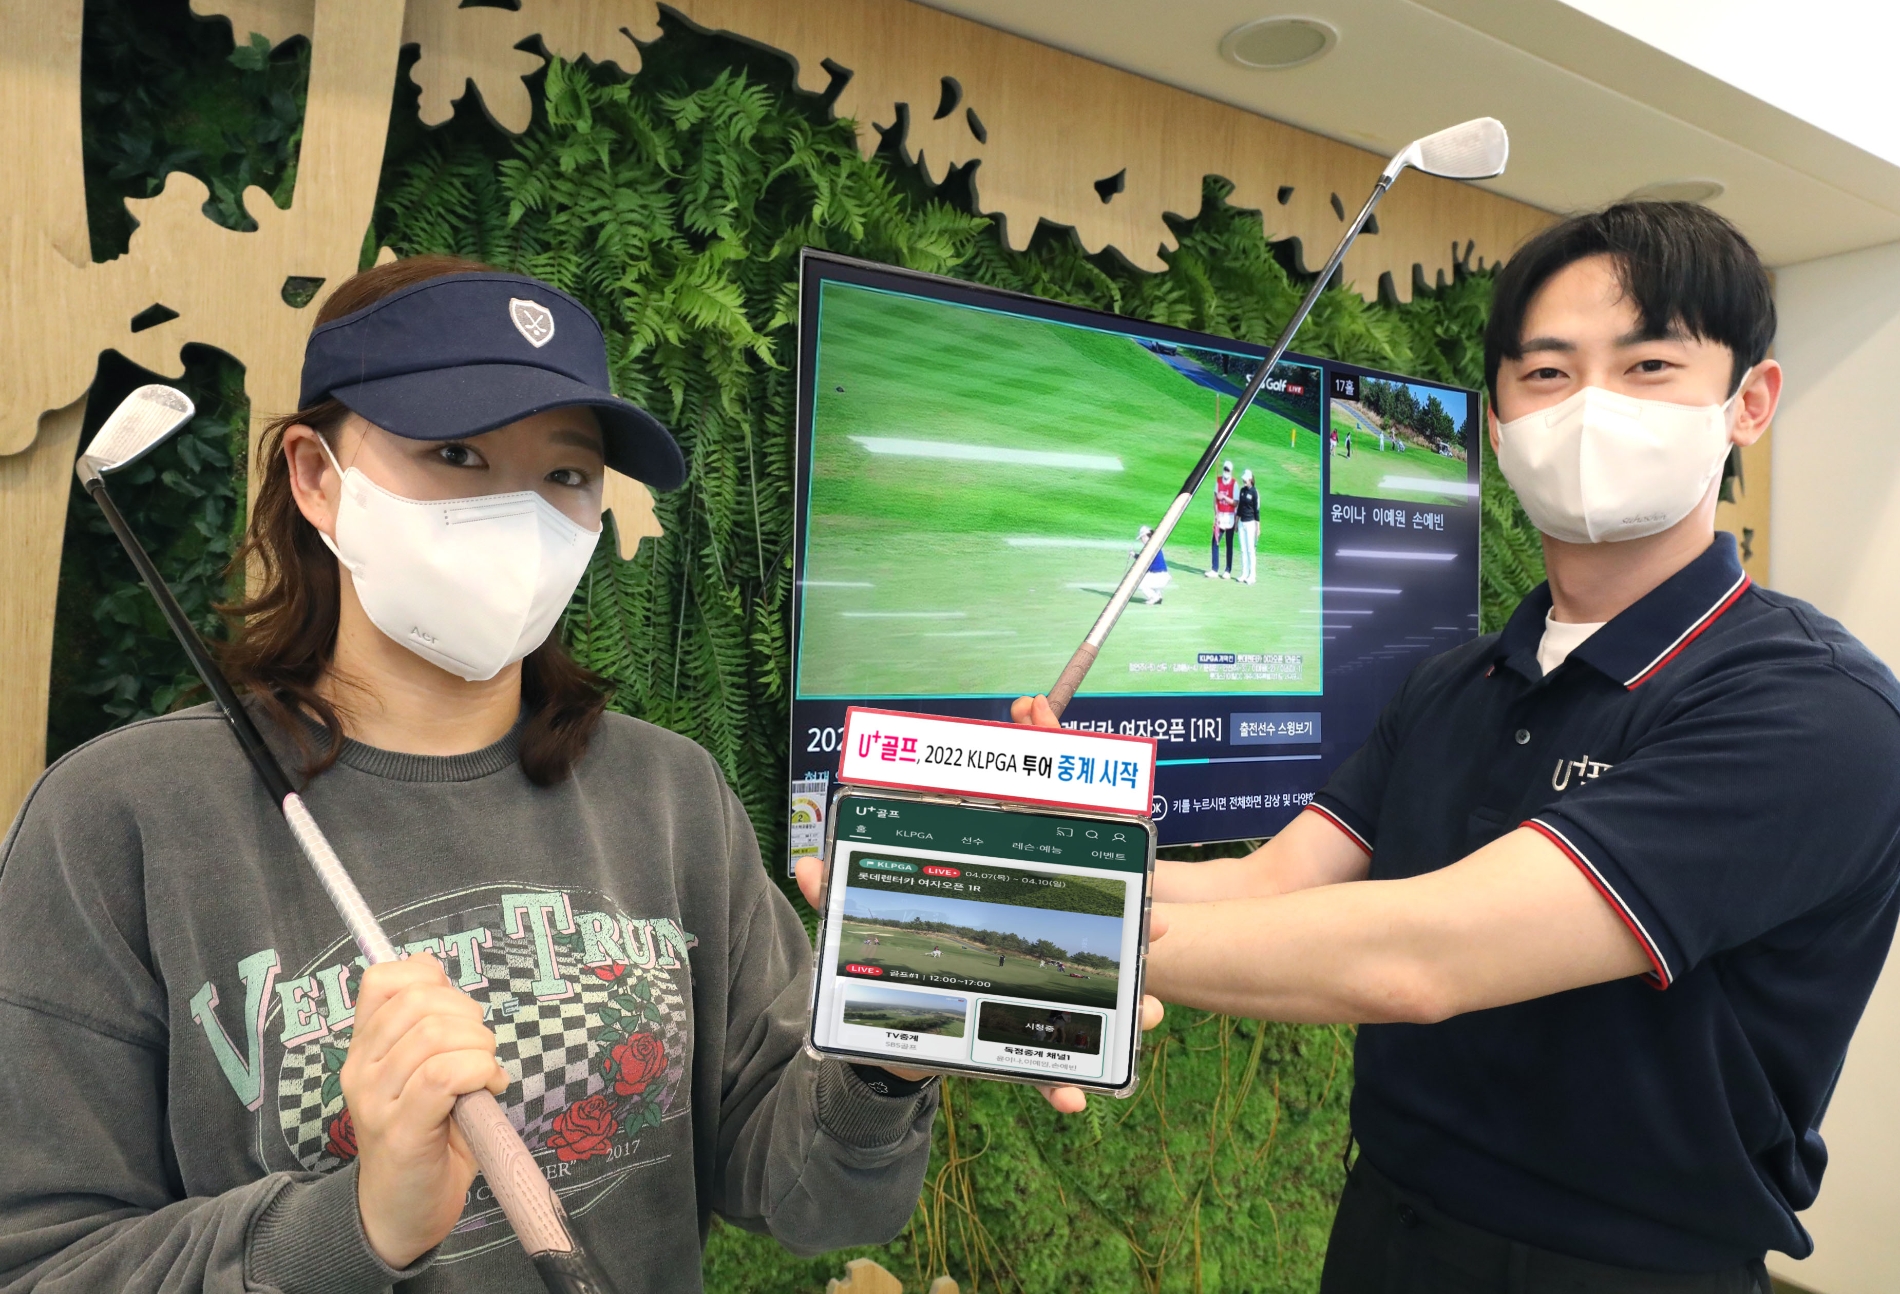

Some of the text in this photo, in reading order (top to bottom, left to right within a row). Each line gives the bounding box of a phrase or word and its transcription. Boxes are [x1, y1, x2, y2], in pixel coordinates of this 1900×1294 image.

[1266, 377, 1287, 392] Golf
[1288, 385, 1302, 394] LIVE
[1335, 378, 1355, 396] 17홀
[1330, 504, 1444, 531] 윤이나 이예원 손예빈
[1119, 718, 1185, 742] 여자오픈
[1190, 718, 1222, 742] [1R]
[1239, 721, 1313, 737] 출전선수 스윙보기
[924, 744, 963, 767] 2022
[967, 749, 1017, 773] KLPGA
[1022, 754, 1053, 779] 투어
[1057, 754, 1095, 784] 중계
[1099, 759, 1139, 789] 시작
[1172, 799, 1190, 814] 키를
[1193, 796, 1227, 812] 누르시면
[1229, 794, 1262, 810] 전체화면
[1264, 793, 1281, 808] 감상
[1282, 793, 1291, 807] 및
[856, 824, 867, 834] 홈
[895, 829, 934, 840] KLPGA
[961, 836, 984, 846] 선수
[1091, 850, 1127, 861] 이벤트
[858, 872, 981, 892] 롯데렌터카 여자오픈 1R
[877, 861, 913, 871] KLPGA
[928, 867, 952, 876] LIVE
[965, 871, 1010, 882] 04.07(목)
[1021, 877, 1066, 888] 04.10(일)
[851, 965, 874, 974] LIVE
[885, 1031, 919, 1042] TV중계
[1025, 1022, 1055, 1033] 시청중
[605, 1139, 641, 1163] 2017
